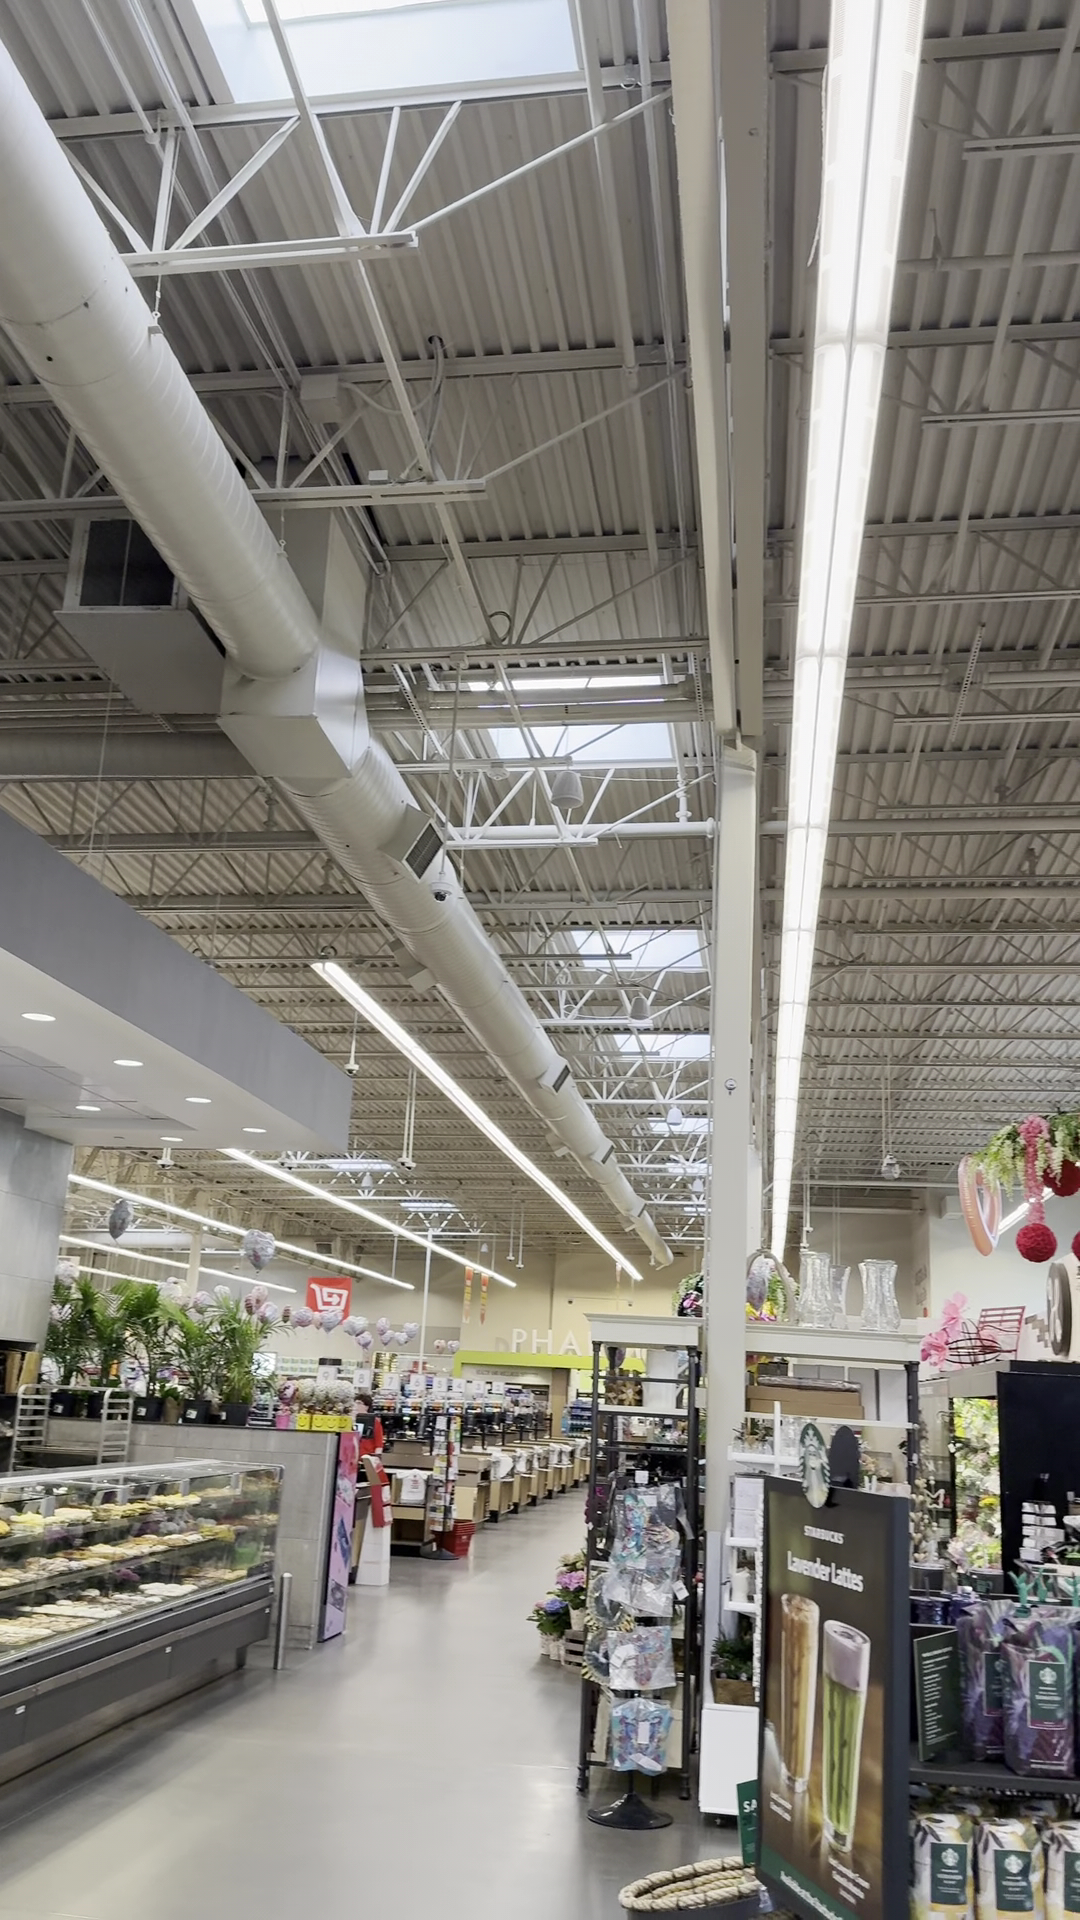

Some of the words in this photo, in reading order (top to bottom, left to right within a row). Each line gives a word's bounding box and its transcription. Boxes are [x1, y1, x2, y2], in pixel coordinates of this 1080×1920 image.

[803, 1525, 845, 1544] STARBUCKS
[787, 1550, 831, 1582] Lavender
[831, 1562, 864, 1592] Lattes
